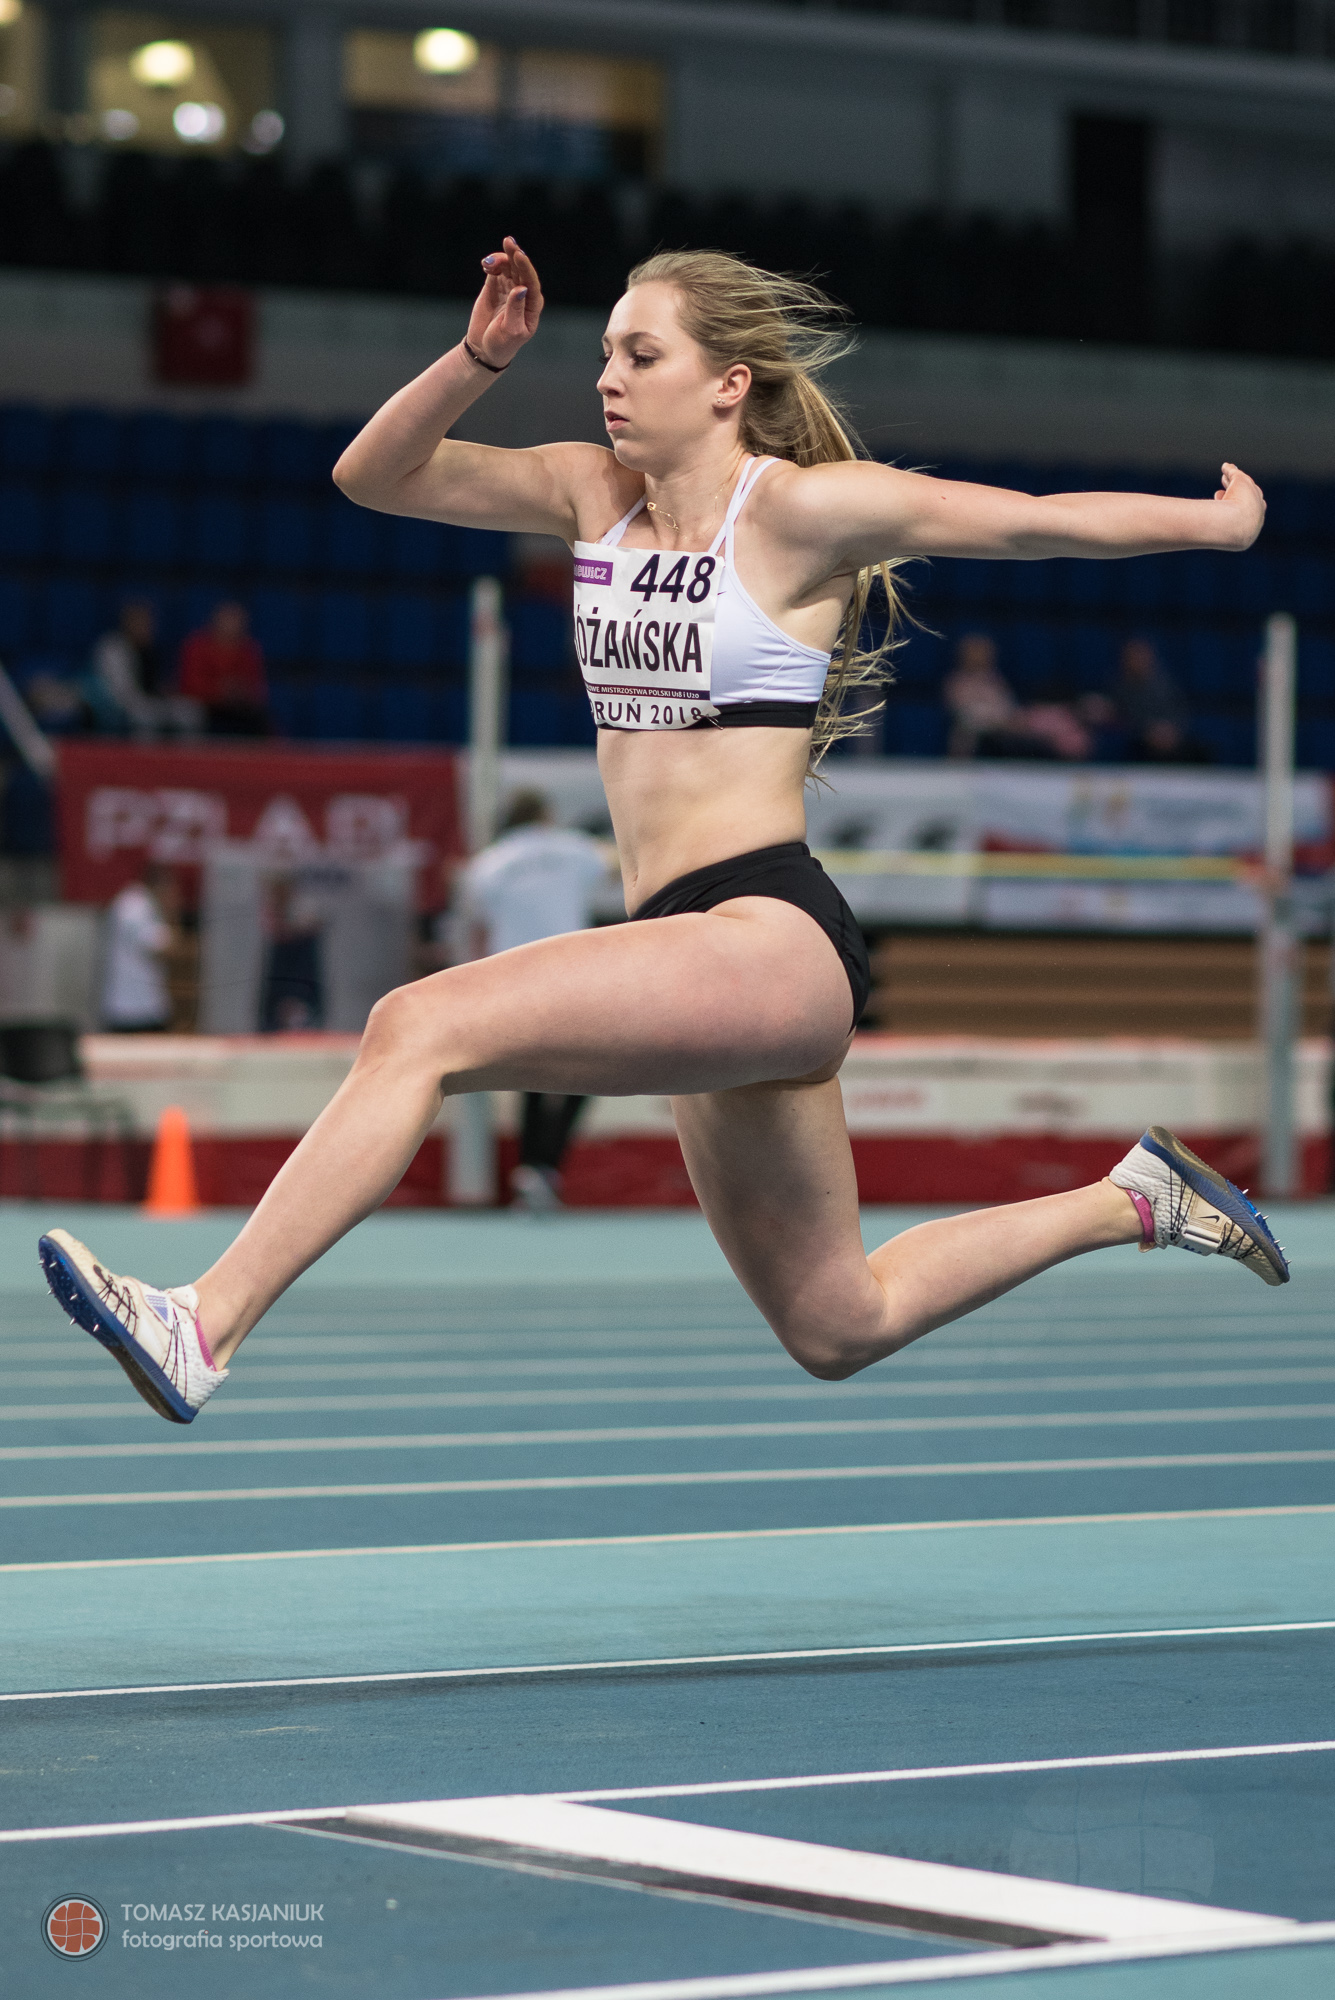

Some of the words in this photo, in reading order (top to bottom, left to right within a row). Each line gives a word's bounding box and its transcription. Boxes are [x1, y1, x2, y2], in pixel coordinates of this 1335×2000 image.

[630, 553, 716, 604] 448
[575, 604, 703, 673] ÓŻAŃSKA
[601, 686, 648, 696] MISTRZOSTWA
[648, 689, 671, 697] POLSKI
[650, 704, 702, 725] 2018
